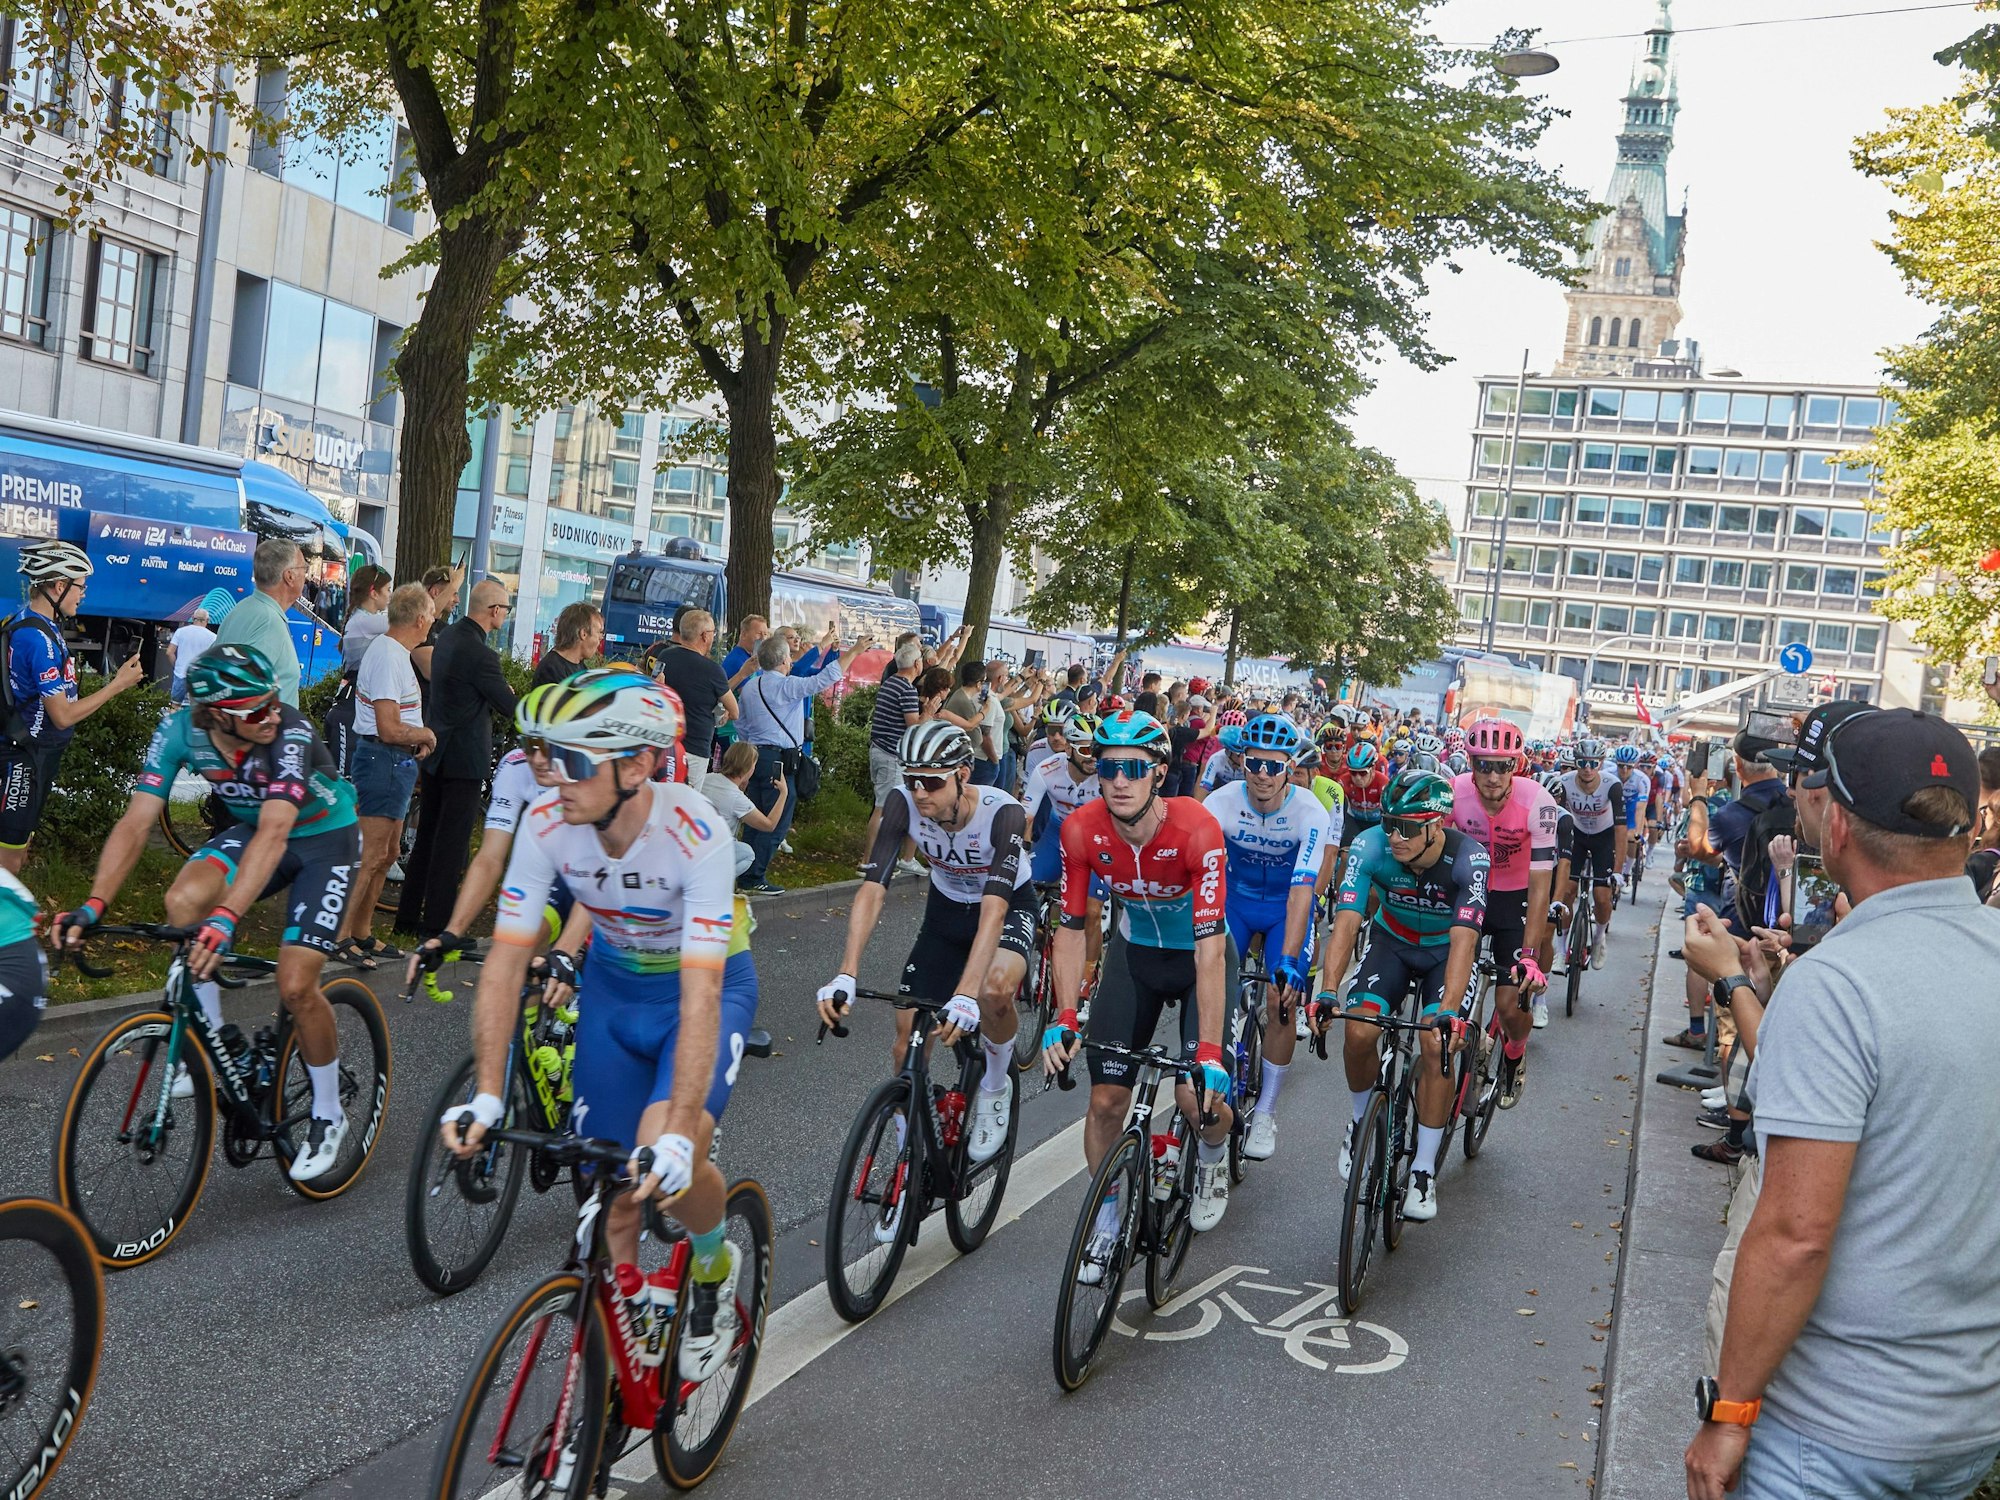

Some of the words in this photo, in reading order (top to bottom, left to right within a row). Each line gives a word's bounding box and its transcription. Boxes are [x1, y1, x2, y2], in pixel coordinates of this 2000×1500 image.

[272, 425, 364, 470] SUBWAY
[1, 473, 83, 508] PREMIER
[1, 503, 52, 533] TECH
[504, 506, 524, 520] Fitness
[113, 527, 142, 540] FACTOR
[501, 521, 514, 534] First
[552, 522, 626, 551] BUDNIKOWSKY
[141, 558, 168, 569] FANTINI
[178, 561, 199, 572] Roland
[214, 565, 238, 577] COGEAS
[544, 565, 592, 586] Kosmetikstudio
[637, 627, 673, 636] GRENADIER
[638, 614, 674, 629] INEOS
[1233, 661, 1280, 687] ARKEA
[597, 717, 675, 746] SPECIALIZED
[337, 722, 347, 776] STEVENS
[5, 762, 23, 812] VENTOUX
[18, 795, 29, 808] DU
[1573, 801, 1602, 812] UAE
[1231, 829, 1294, 848] Jayco
[1303, 827, 1319, 866] GIANT
[923, 841, 985, 865] UAE
[1156, 848, 1179, 858] CAPS
[1103, 874, 1184, 898] lotto
[1200, 848, 1223, 905] lotto
[315, 865, 350, 931] BORA
[1388, 891, 1451, 910] BORA
[1195, 907, 1221, 918] efficy
[1194, 920, 1218, 931] viking
[1195, 927, 1215, 937] lotto
[1102, 1060, 1128, 1071] viking
[1102, 1066, 1124, 1077] lotto
[363, 1071, 388, 1156] roval
[925, 1073, 945, 1150] COLNAGO
[112, 1217, 174, 1258] roval
[8, 1386, 81, 1500] roval
